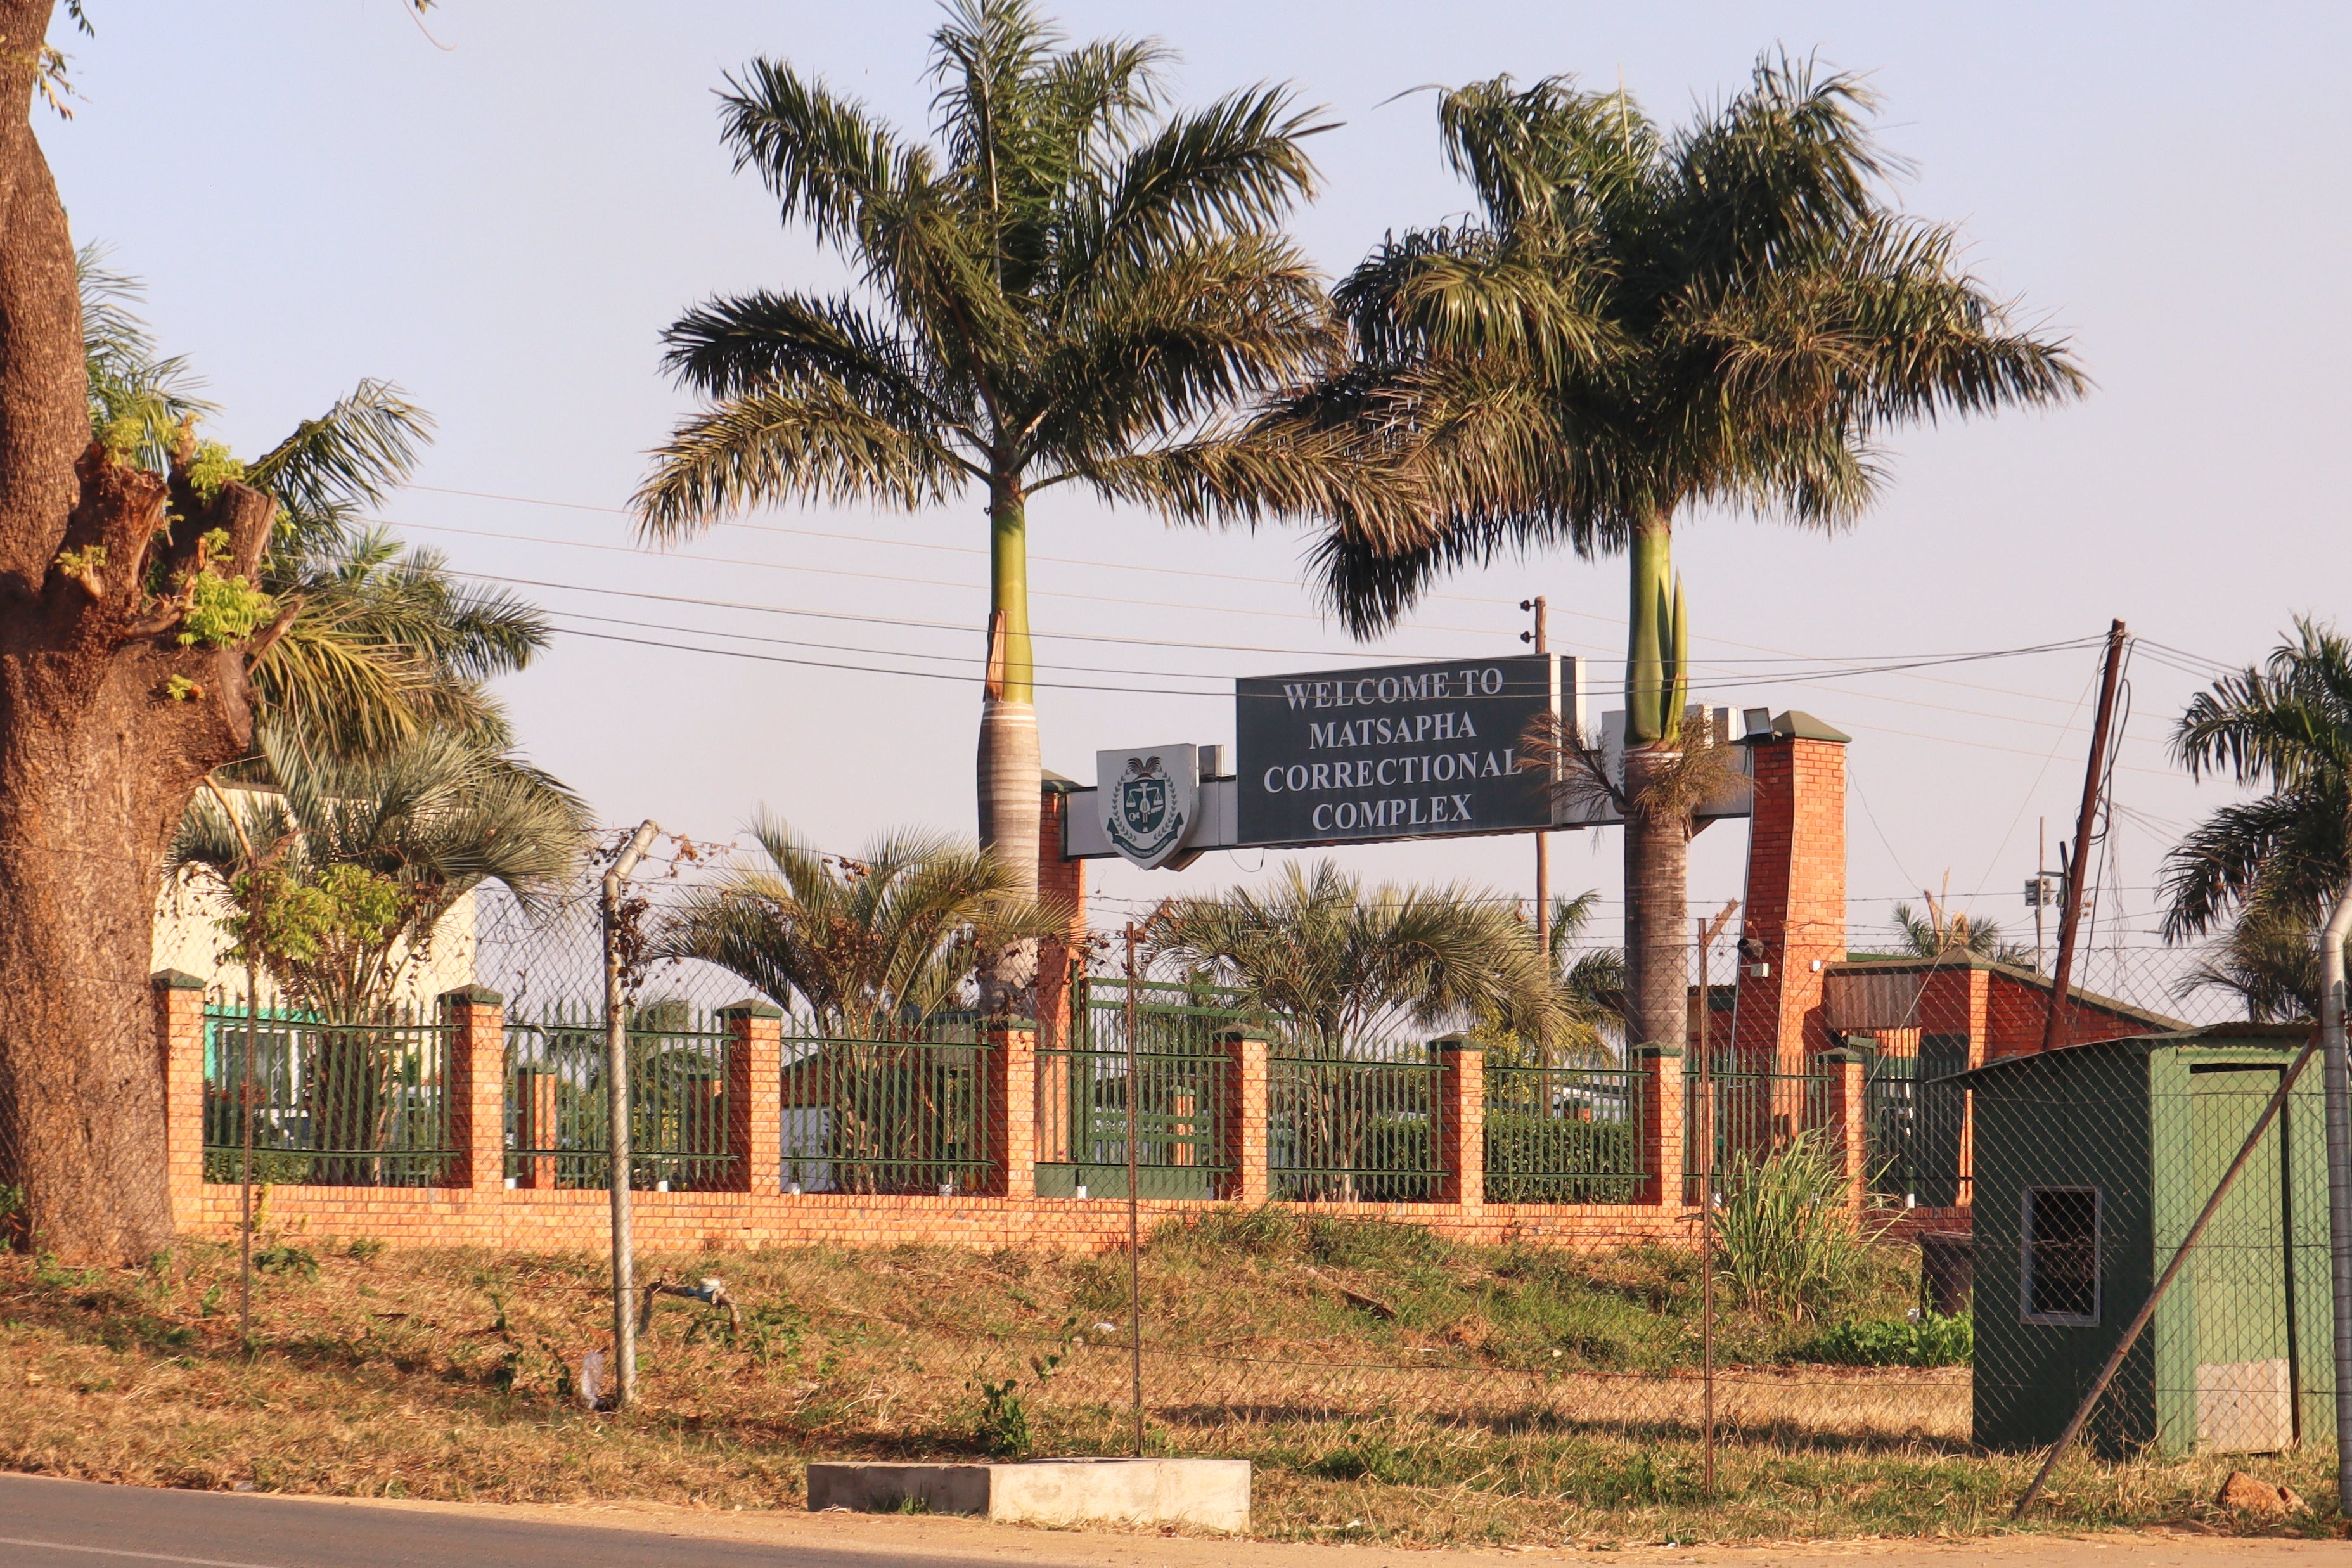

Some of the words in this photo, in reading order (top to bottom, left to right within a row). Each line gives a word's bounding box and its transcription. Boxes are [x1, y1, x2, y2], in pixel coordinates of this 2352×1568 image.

[1283, 672, 1451, 710] WELCOME
[1459, 668, 1503, 697] TO
[1309, 711, 1477, 749] MATSAPHA
[1263, 749, 1522, 794] CORRECTIONAL
[1312, 794, 1472, 830] COMPLEX
